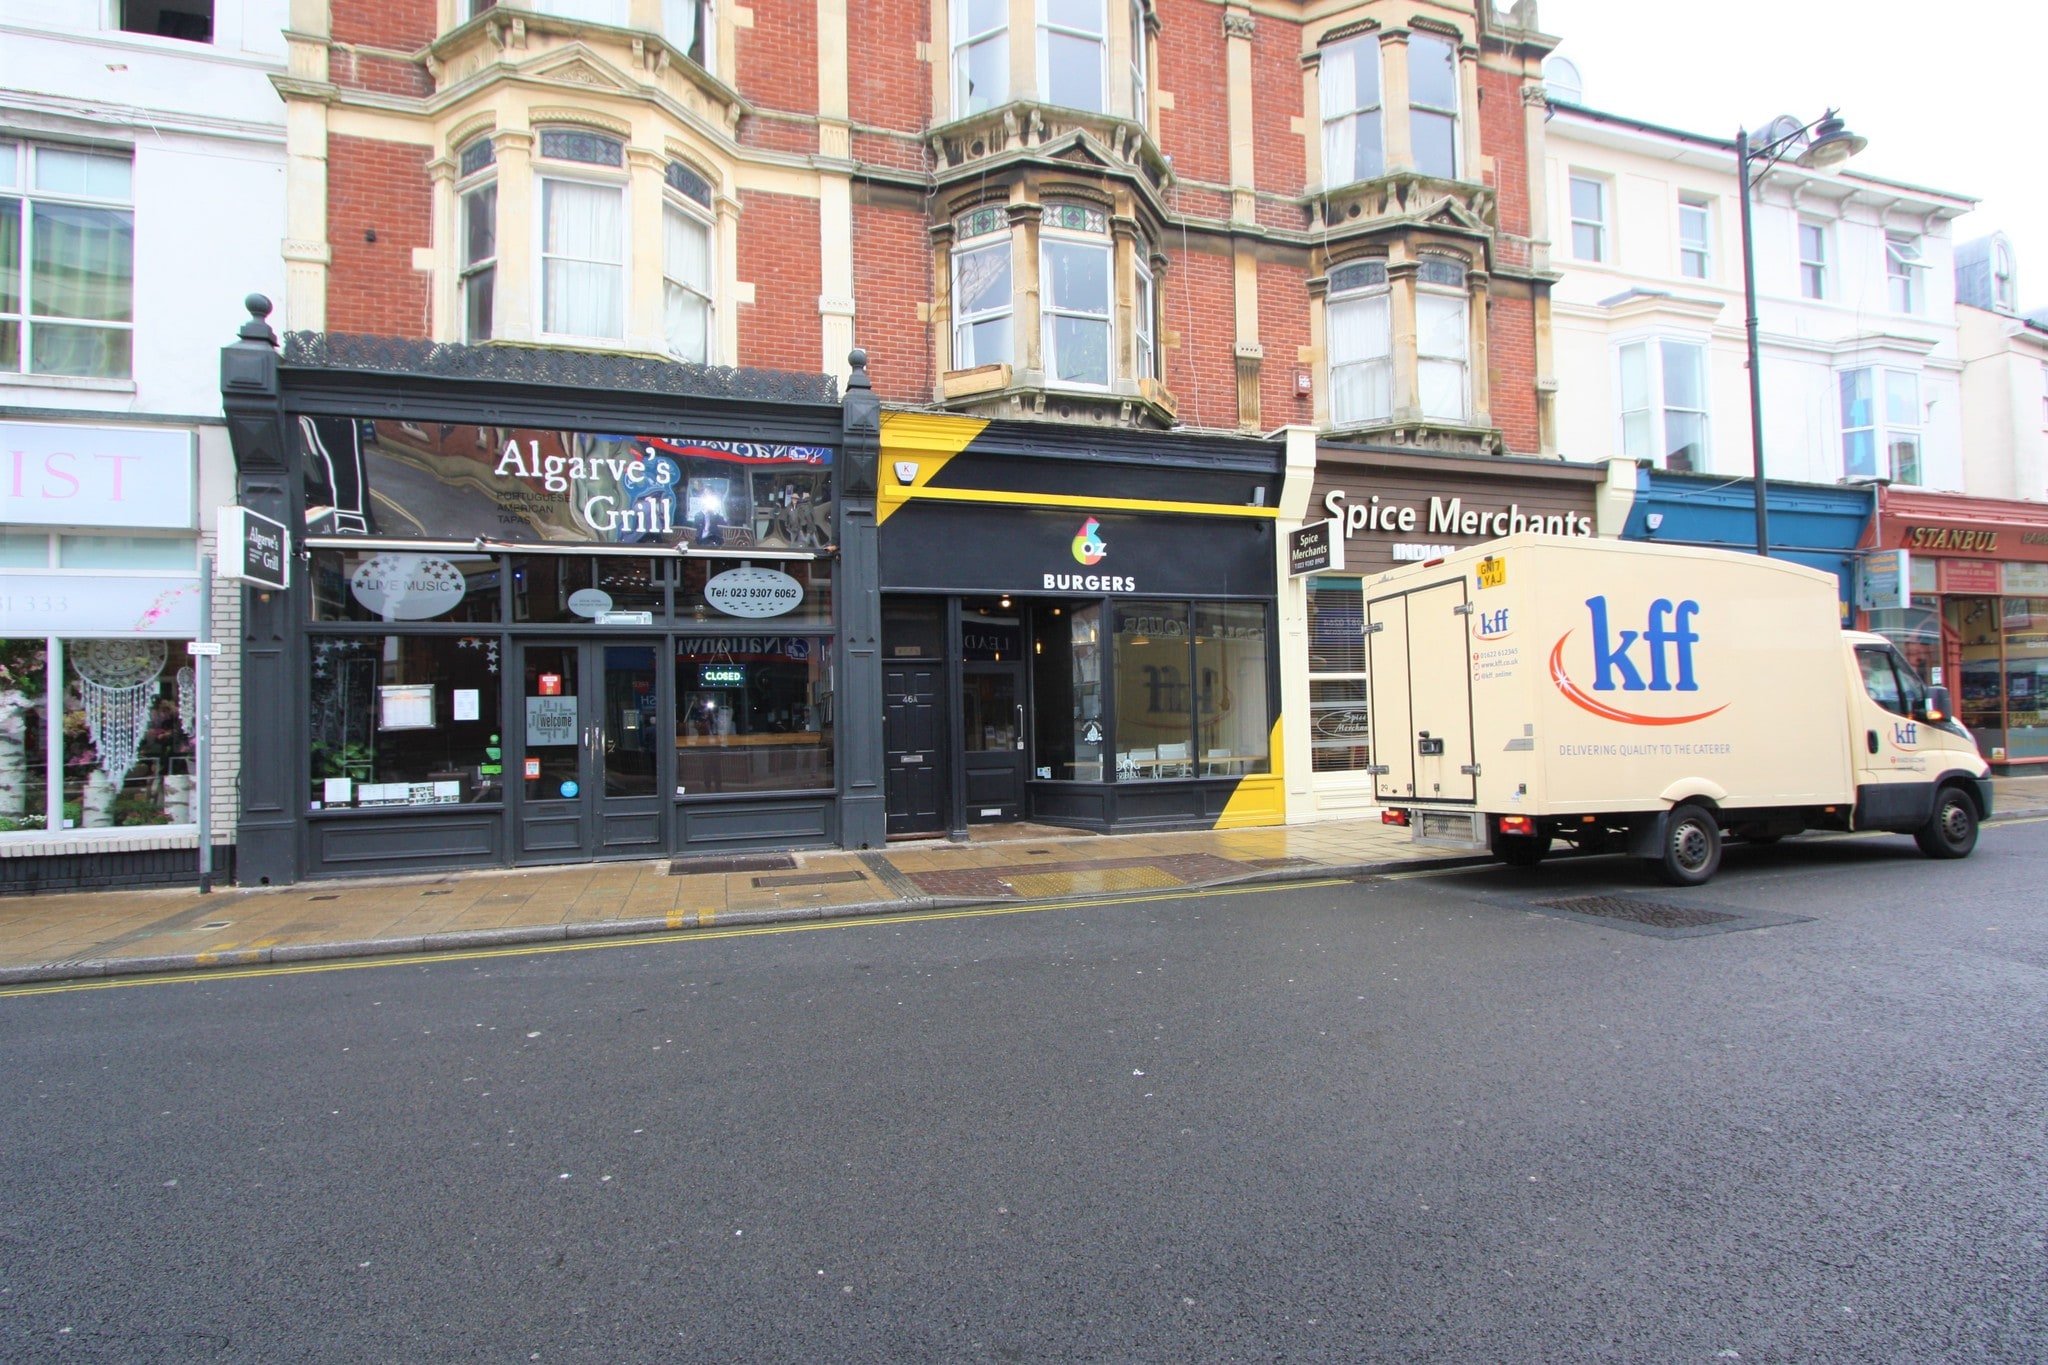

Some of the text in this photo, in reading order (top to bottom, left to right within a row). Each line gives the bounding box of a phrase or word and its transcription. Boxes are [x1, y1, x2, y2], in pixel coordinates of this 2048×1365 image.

[494, 438, 671, 493] Algarve's
[496, 491, 571, 503] PORTUGUESE
[496, 503, 554, 513] AMERICAN
[583, 495, 674, 534] Grill
[1323, 489, 1592, 539] Spice Merchants
[497, 514, 532, 525] TAPAS
[249, 526, 279, 551] Algarve's
[1300, 533, 1319, 548] Spice
[1292, 544, 1328, 561] Merchants
[263, 552, 279, 571] Grill
[1481, 559, 1500, 575] GN17
[366, 580, 450, 592] LIVE MUSIC
[1043, 573, 1136, 592] BURGERS
[1484, 571, 1502, 586] YAJ
[710, 587, 797, 599] Tel: 023 9307 6062
[1480, 608, 1509, 635] kff
[1585, 595, 1700, 692] kff
[705, 671, 741, 681] CLOSED
[902, 695, 918, 703] 46A
[540, 713, 572, 727] welcome
[1894, 722, 1917, 745] kff
[1559, 743, 1732, 757] DELIVERING QUALITY TO THE CATERER
